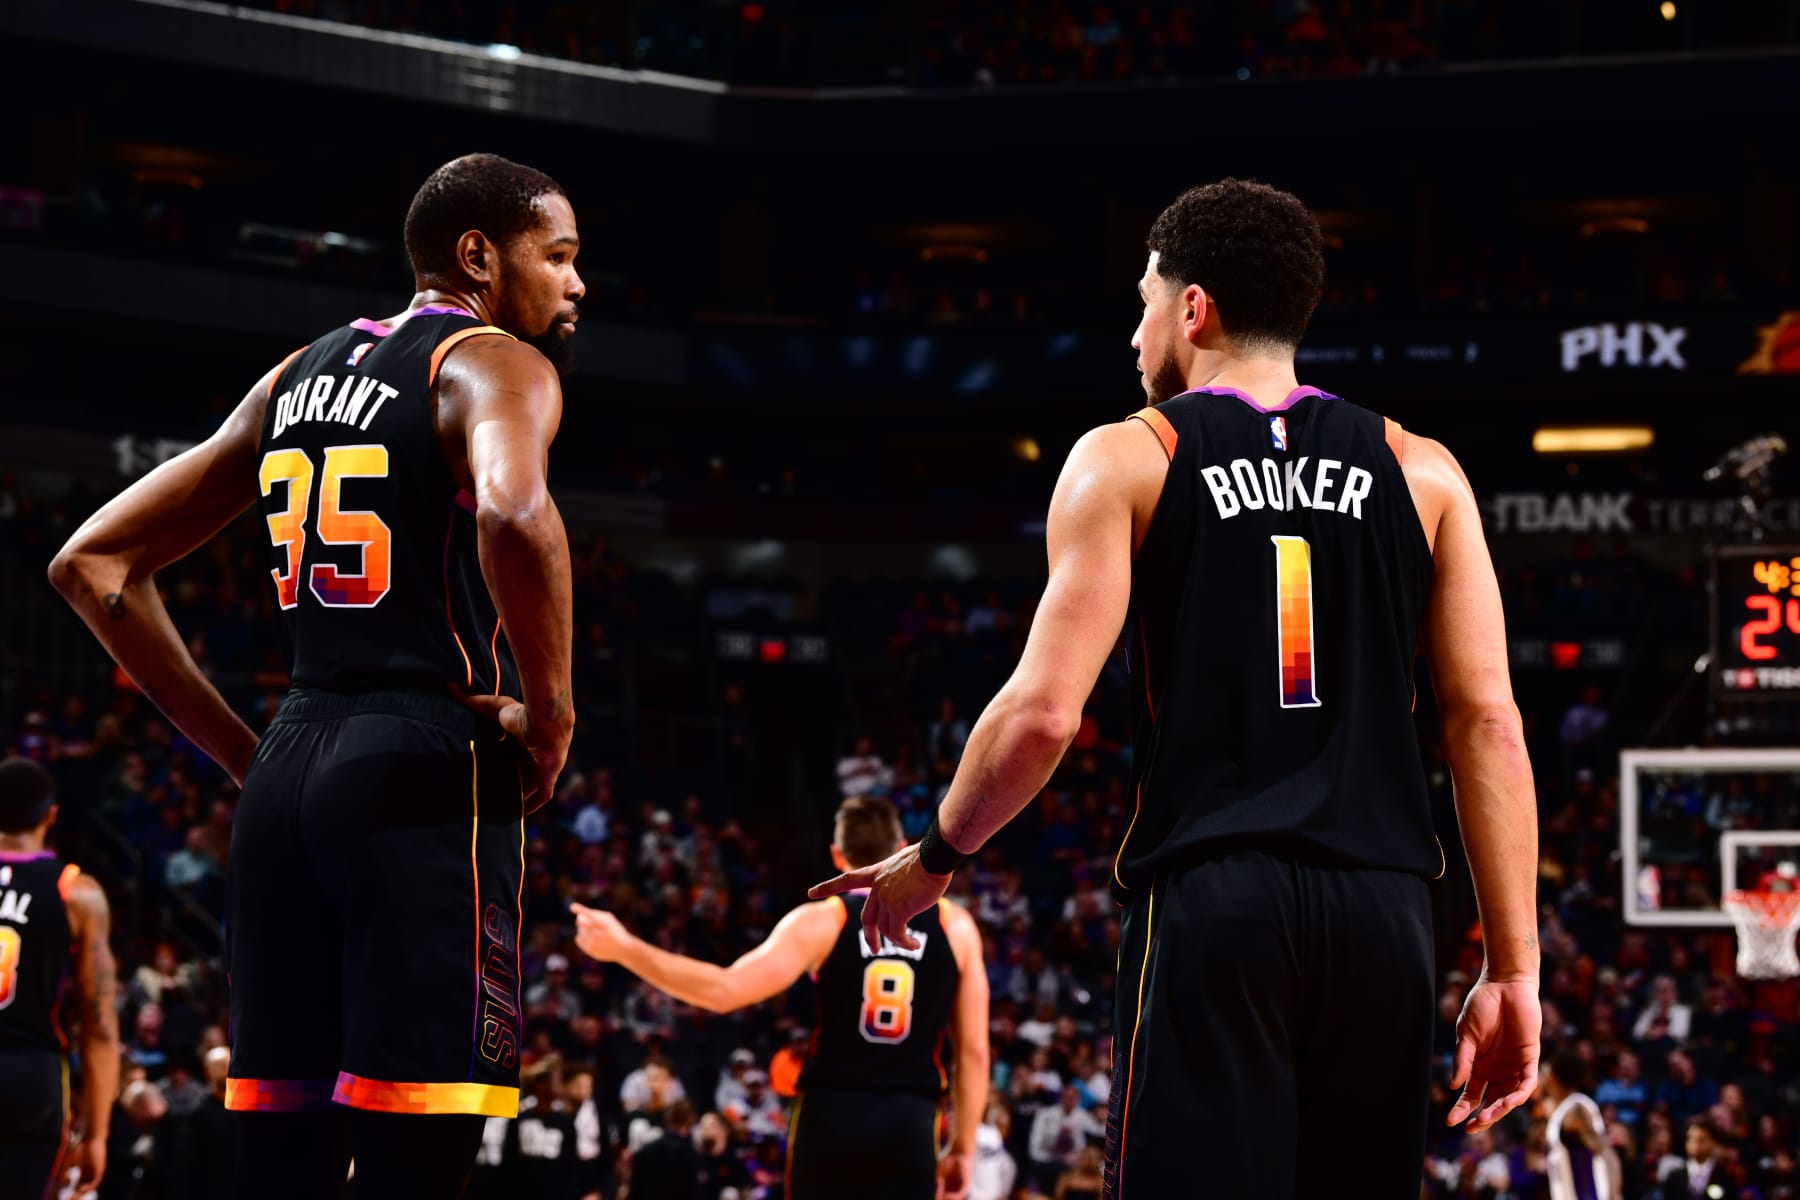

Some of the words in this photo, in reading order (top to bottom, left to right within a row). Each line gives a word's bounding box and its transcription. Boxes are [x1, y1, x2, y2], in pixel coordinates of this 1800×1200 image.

[1560, 321, 1687, 372] PHX
[273, 375, 399, 439] DURANT
[1200, 456, 1373, 520] BOOKER
[258, 444, 392, 611] 35
[1270, 534, 1323, 709] 1
[858, 958, 915, 1046] 8
